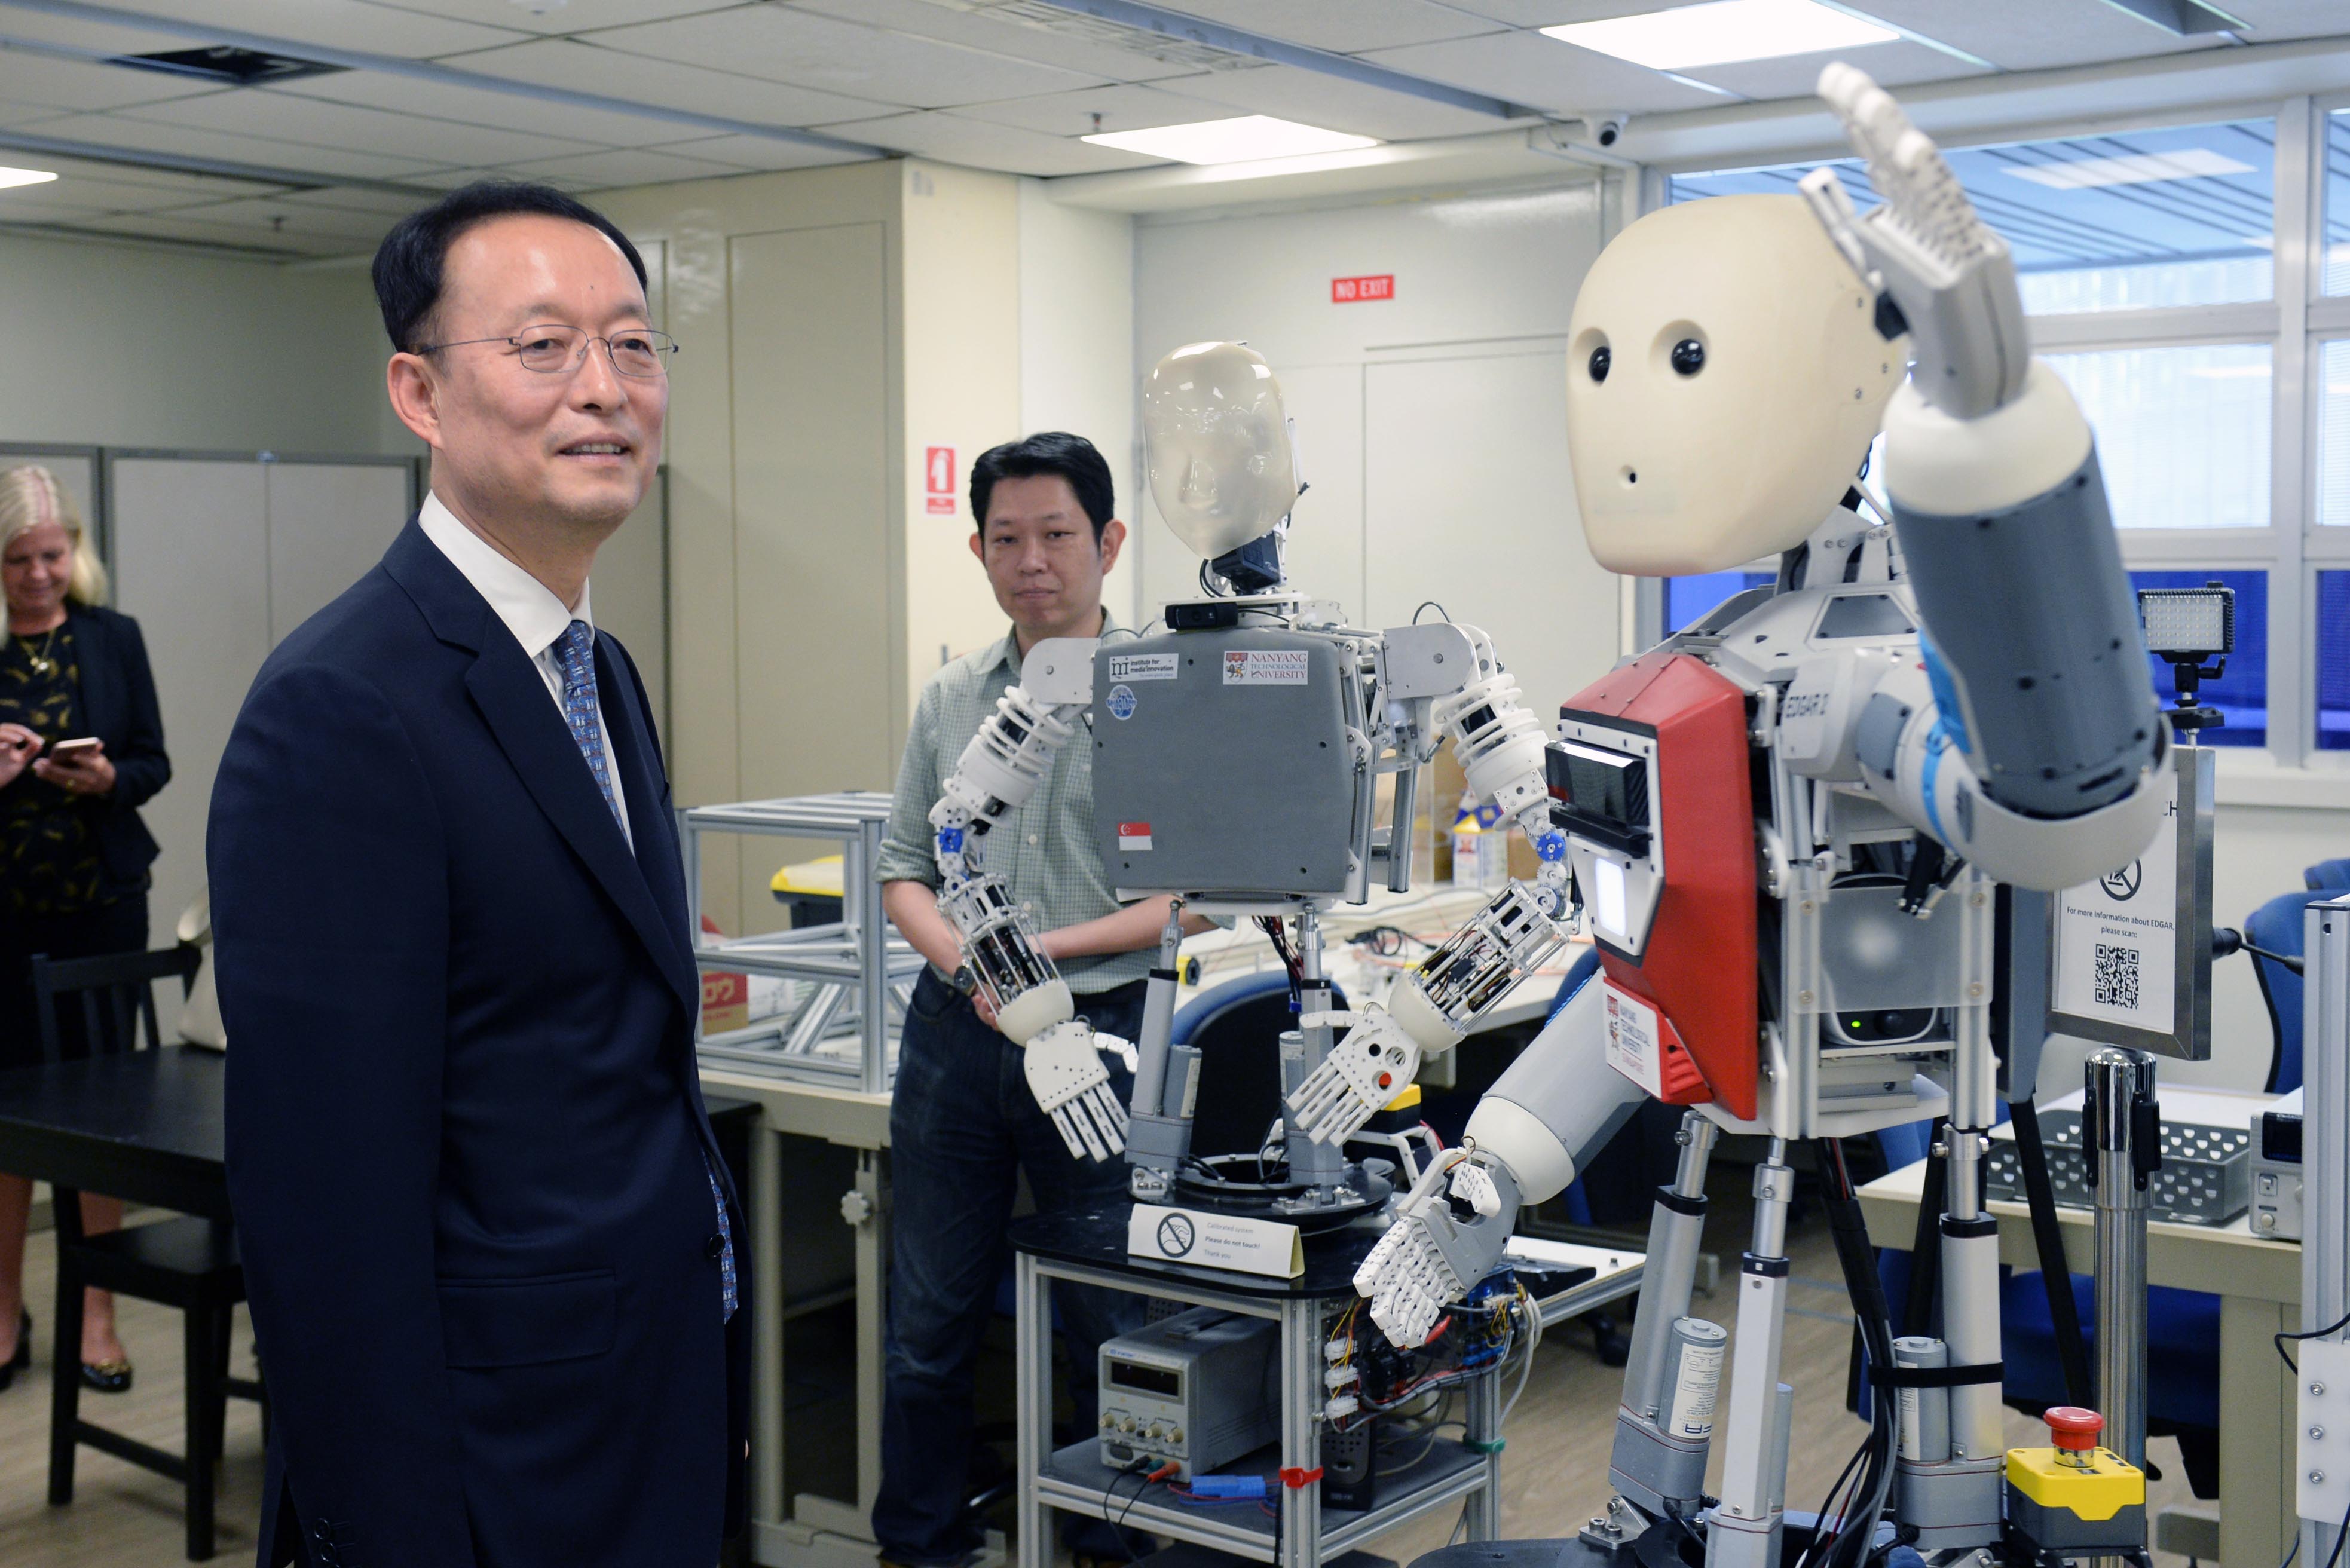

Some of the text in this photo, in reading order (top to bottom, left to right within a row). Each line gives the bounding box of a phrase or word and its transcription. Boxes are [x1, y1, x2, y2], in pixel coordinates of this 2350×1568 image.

[1336, 277, 1388, 299] NO EXIT
[1251, 653, 1307, 663] NANYANG
[1250, 670, 1306, 679] UNIVERSITY
[2067, 906, 2076, 914] For
[2094, 910, 2130, 923] information
[2131, 917, 2149, 926] about
[2151, 920, 2175, 932] EDGAR,
[2101, 926, 2137, 938] please scan:
[1205, 1235, 1222, 1244] Please
[1204, 1249, 1220, 1257] Thank
